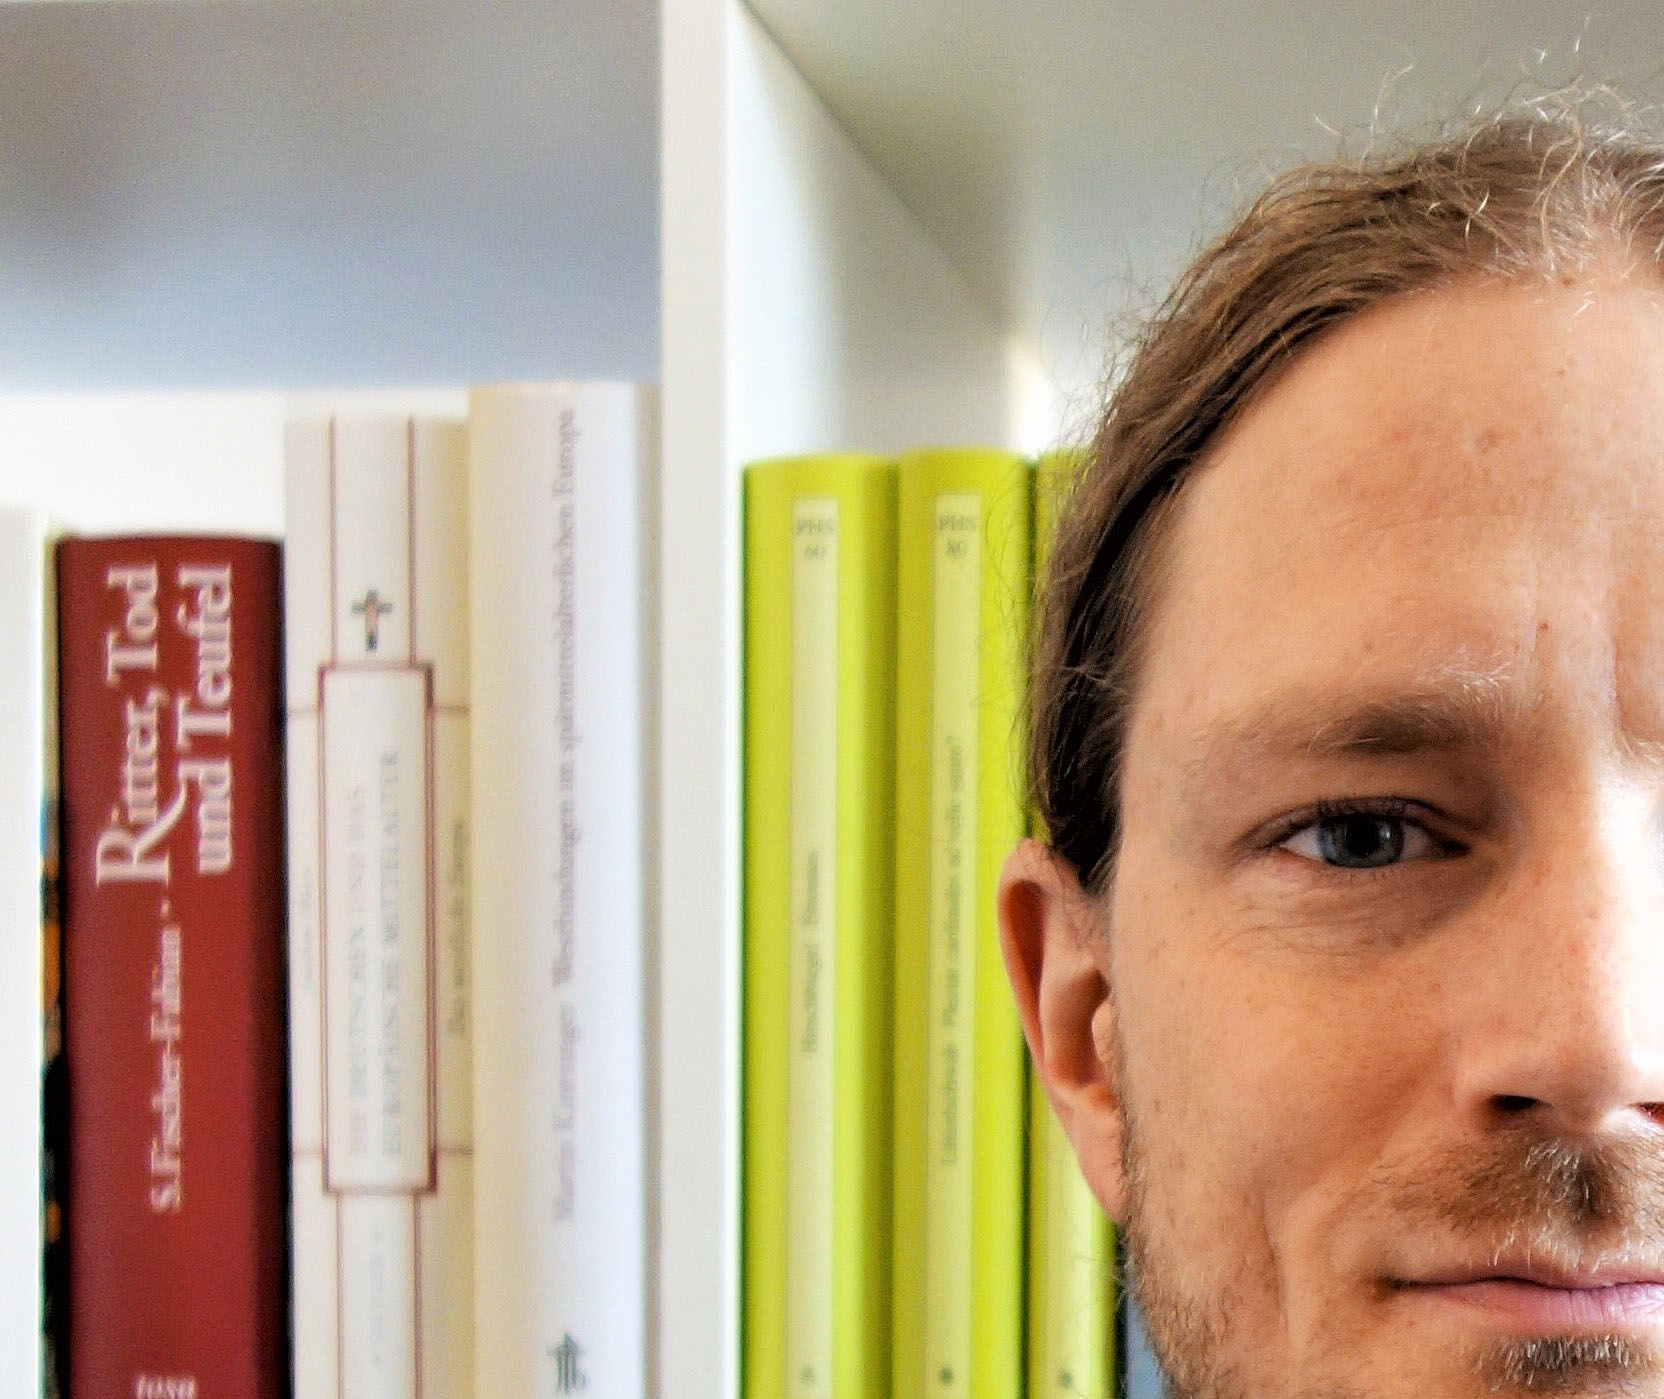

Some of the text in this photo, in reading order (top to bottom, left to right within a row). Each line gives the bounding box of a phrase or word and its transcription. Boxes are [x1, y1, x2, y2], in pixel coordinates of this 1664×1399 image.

[550, 408, 580, 497] Europa
[96, 564, 186, 885] Ritter, Tod
[178, 564, 232, 874] und Teufel
